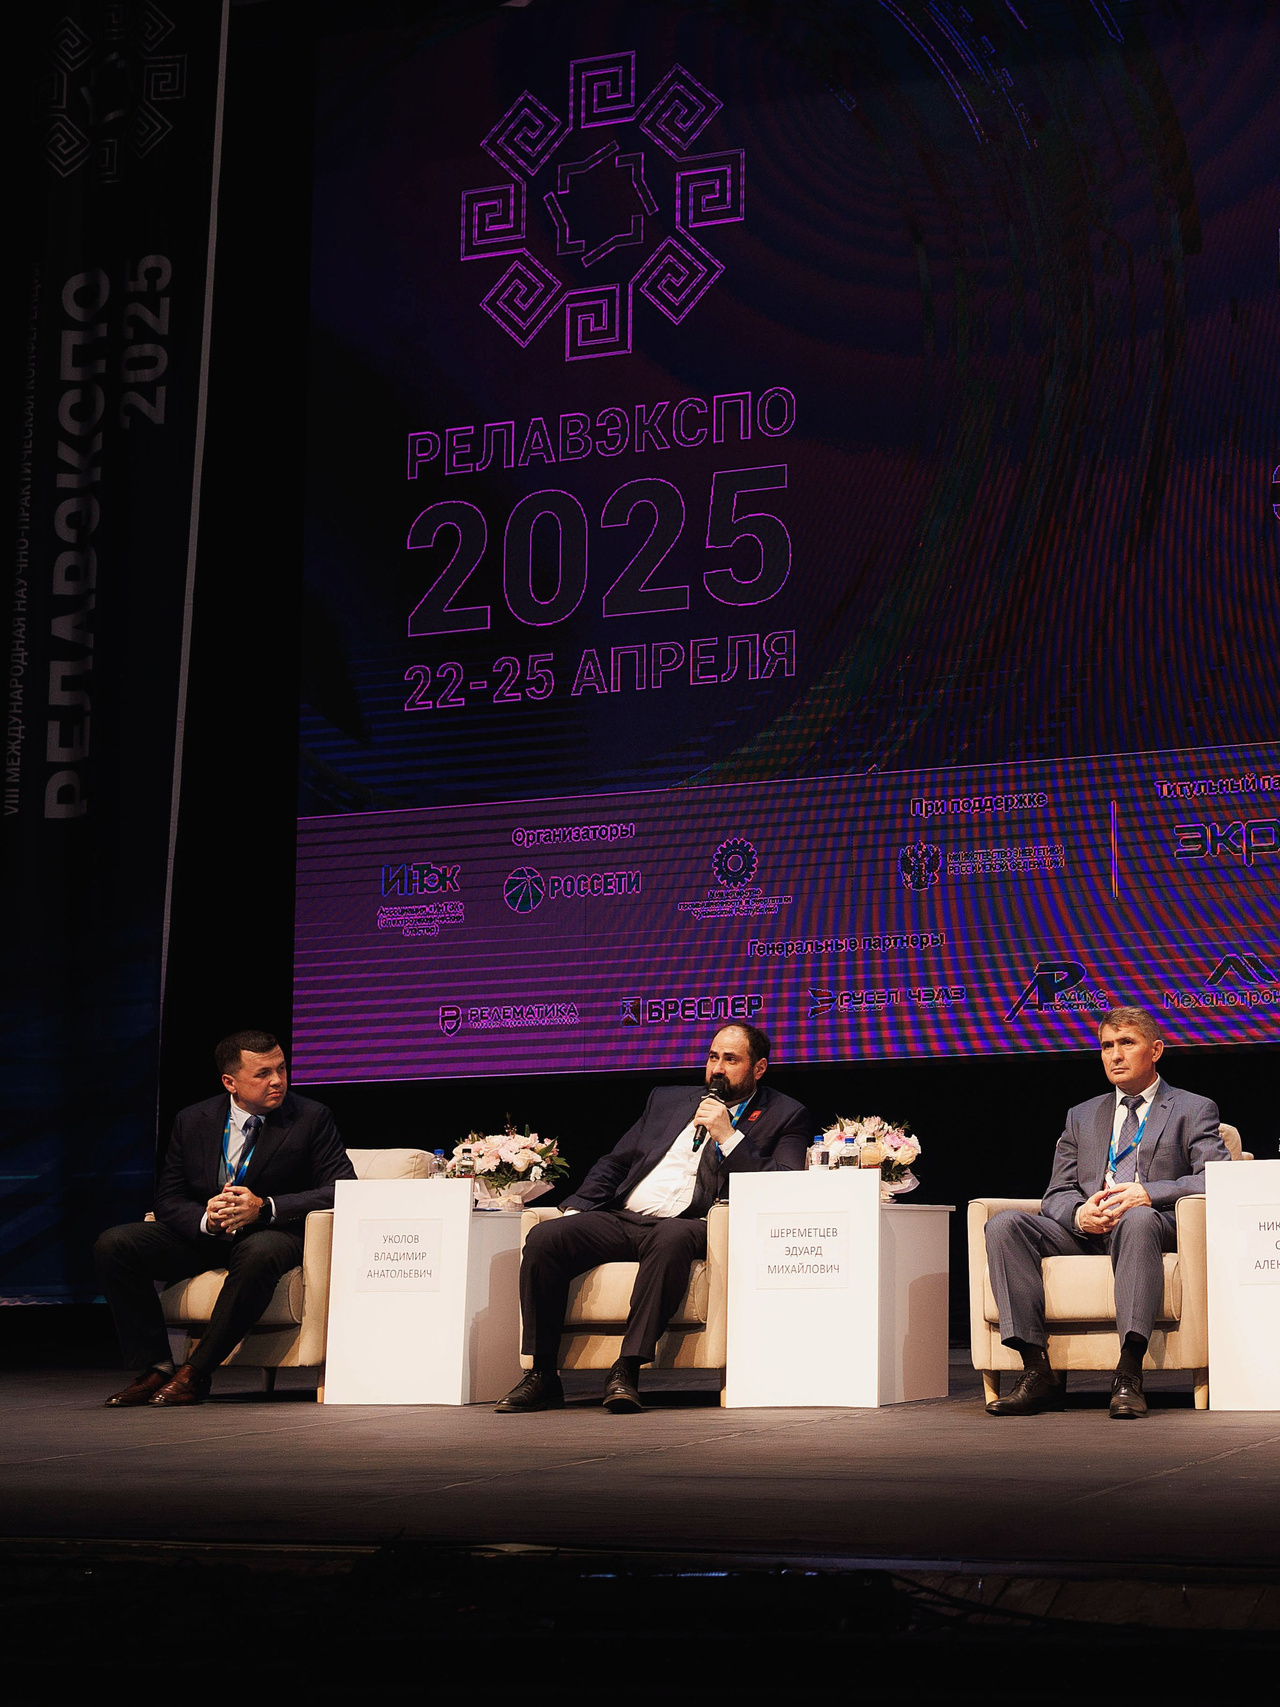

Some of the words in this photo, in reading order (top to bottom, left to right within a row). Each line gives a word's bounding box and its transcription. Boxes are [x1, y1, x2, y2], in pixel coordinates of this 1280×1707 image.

[118, 253, 173, 427] 2025
[407, 387, 796, 479] РЕЛАВЭКСПО
[43, 267, 111, 820] РЕЛАВЭКСПО
[407, 464, 792, 637] 2025
[404, 653, 554, 711] 22-25
[571, 630, 796, 697] АПРЕЛЯ
[5, 617, 27, 783] МЕЖДУНАРОДНАЯ
[1154, 773, 1258, 799] Титульный
[911, 797, 945, 818] При
[949, 792, 1048, 814] поддержке
[511, 823, 635, 847] Организаторы
[550, 871, 642, 899] РОССЕТИ
[748, 937, 858, 957] Генеральные
[861, 932, 946, 952] партнеры
[907, 985, 966, 1003] ЧЭАЗ
[469, 1002, 579, 1021] РЕЛЕМАТИКА
[647, 994, 763, 1023] БРЕСЛЕР
[382, 1234, 420, 1244] УКОЛОВ
[770, 1227, 838, 1239] ШЕРЕМЕТЦЕВ
[374, 1252, 427, 1262] ВЛАДИМИР
[784, 1246, 823, 1257] ЭДУАРД
[367, 1269, 432, 1279] АНАТОЛЬЕВИЧ
[767, 1263, 840, 1274] МИХАЙЛОВИЧ
